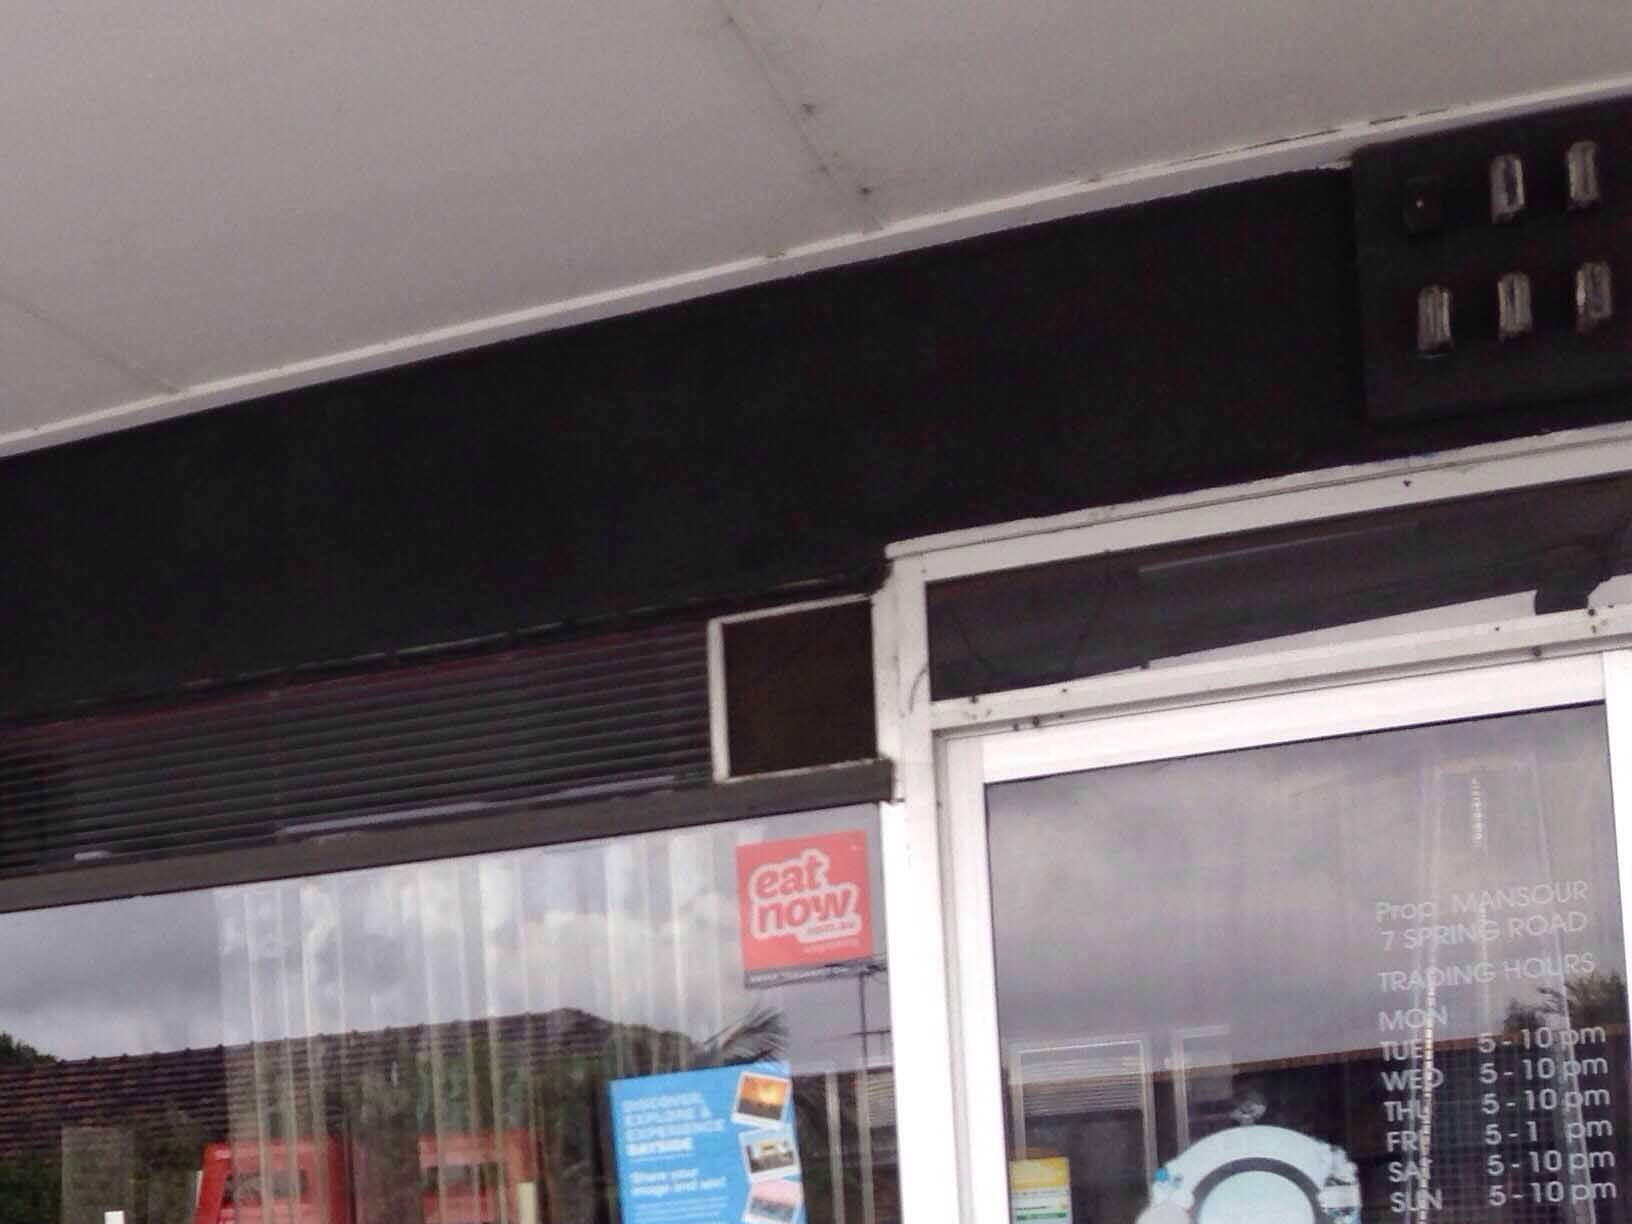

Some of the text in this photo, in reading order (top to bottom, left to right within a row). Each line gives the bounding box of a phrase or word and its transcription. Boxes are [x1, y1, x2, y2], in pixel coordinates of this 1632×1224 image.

[755, 854, 823, 899] eat
[757, 889, 852, 934] now
[1452, 880, 1590, 914] MANSOUR
[1380, 911, 1588, 951] 7 SPRING ROAD
[1378, 952, 1596, 992] TRADING HOURS
[1377, 1006, 1447, 1032] MON
[1379, 1038, 1425, 1061] TUE
[1477, 1033, 1496, 1053] 5
[1521, 1027, 1553, 1050] 10
[1560, 1026, 1606, 1048] pm
[1380, 1067, 1445, 1091] WED
[1479, 1063, 1498, 1084] 5
[1522, 1058, 1555, 1080] 10
[1562, 1057, 1608, 1080] pm
[1383, 1099, 1431, 1122] THU
[1481, 1094, 1500, 1115] 5
[1525, 1088, 1557, 1111] 10
[1563, 1088, 1610, 1112] pm
[1484, 1124, 1502, 1145] 5
[1567, 1119, 1613, 1143] pm
[1388, 1159, 1433, 1183] SAT
[1487, 1154, 1505, 1176] 5
[1529, 1150, 1562, 1172] 10
[1568, 1150, 1615, 1174] pm
[1390, 1188, 1443, 1213] SUN
[1489, 1185, 1506, 1206] 5
[1530, 1181, 1564, 1203] 10
[1570, 1181, 1617, 1203] pm
